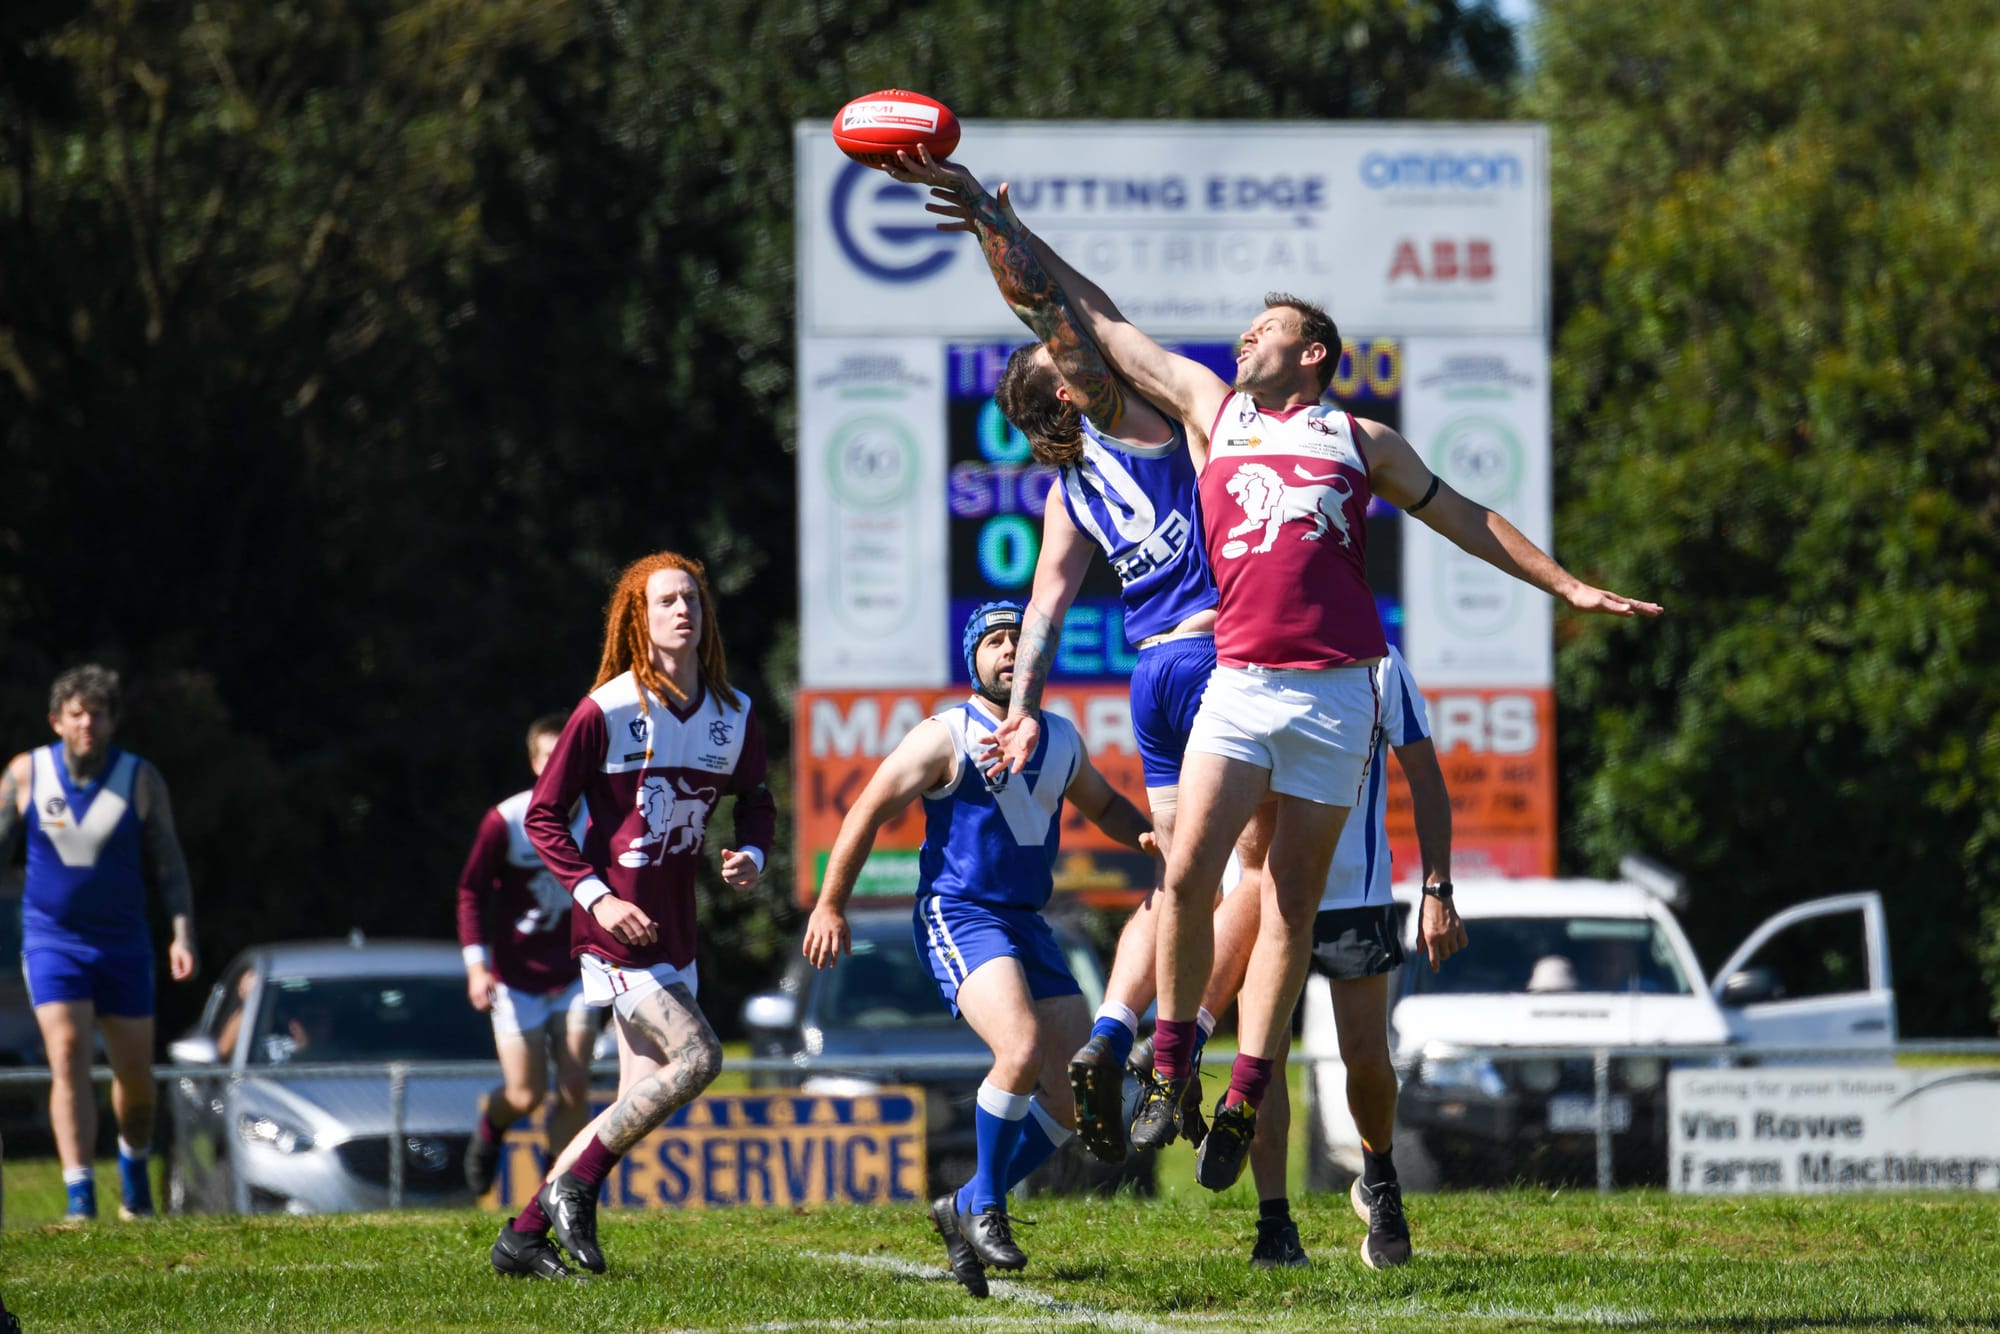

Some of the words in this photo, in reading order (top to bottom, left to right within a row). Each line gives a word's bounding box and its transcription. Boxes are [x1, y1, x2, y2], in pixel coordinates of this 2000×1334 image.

[1206, 176, 1326, 211] EDGE
[1387, 240, 1495, 281] ABB
[1681, 1109, 1738, 1140] Vin
[1754, 1109, 1864, 1140] Rowe
[496, 1137, 916, 1207] TESERVICE
